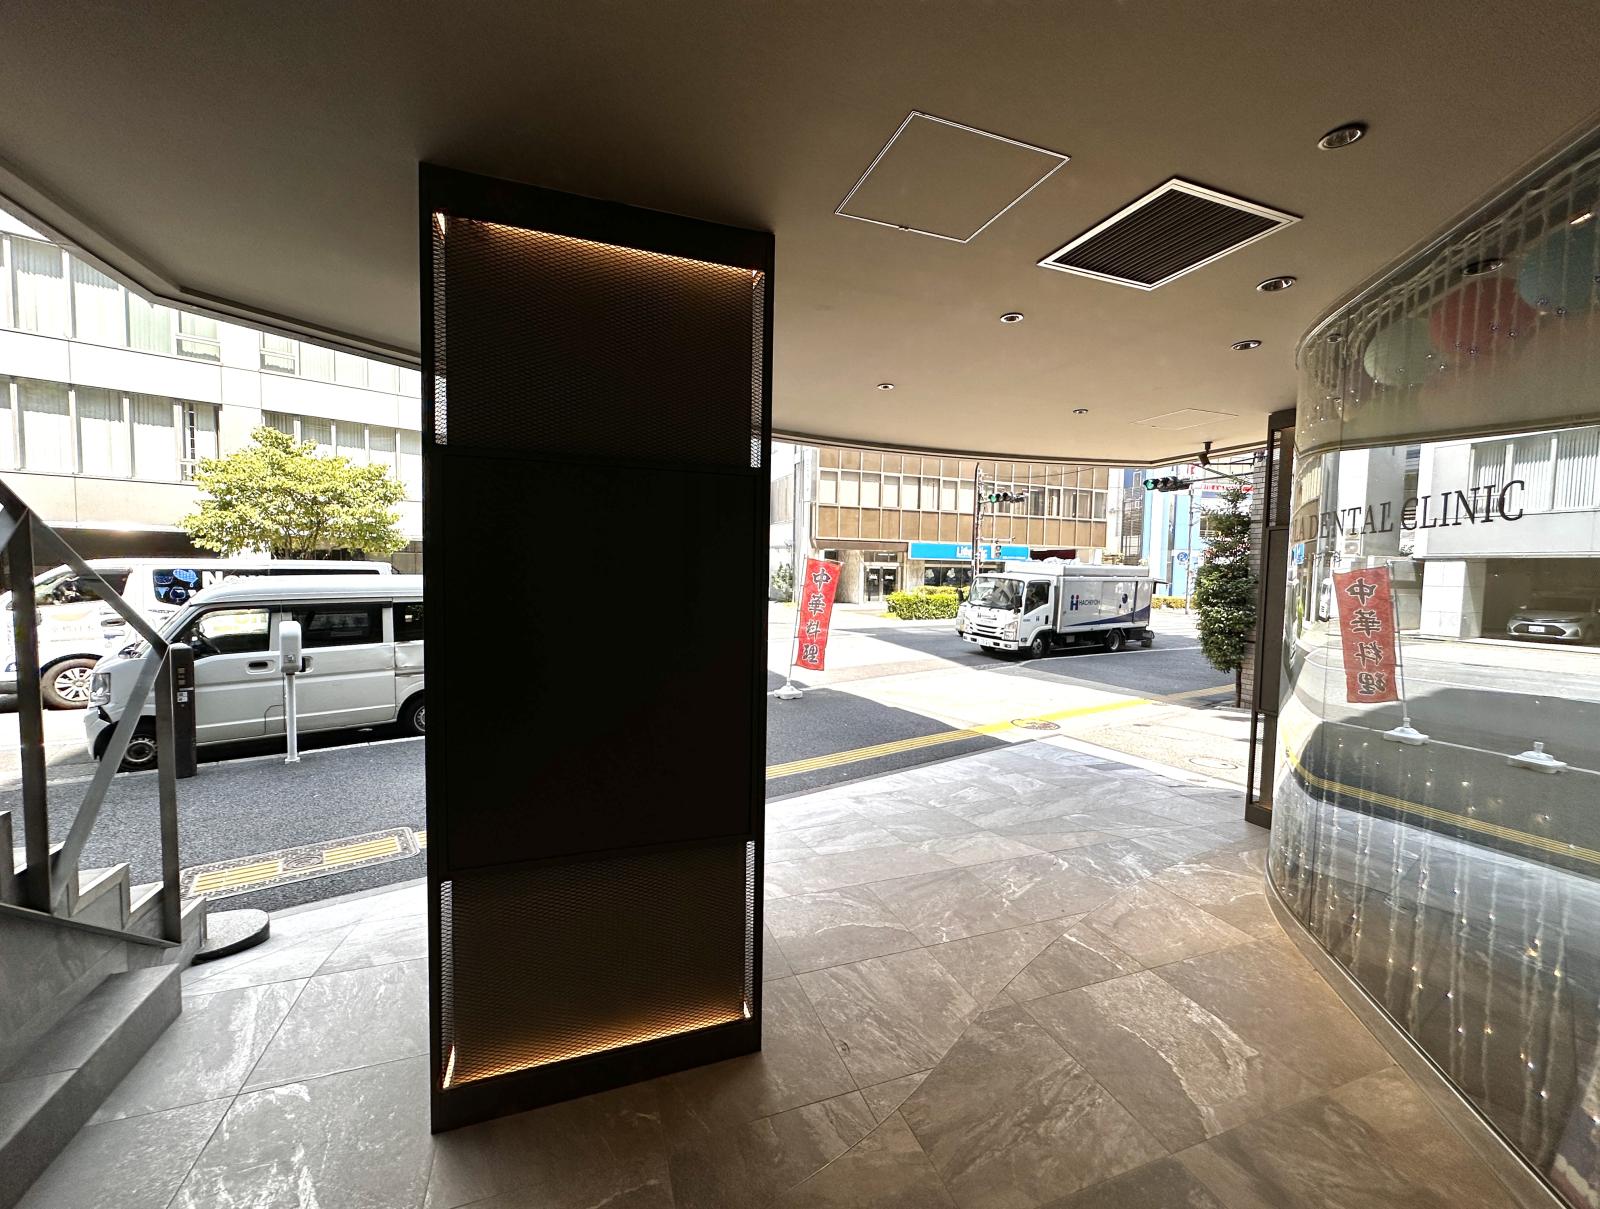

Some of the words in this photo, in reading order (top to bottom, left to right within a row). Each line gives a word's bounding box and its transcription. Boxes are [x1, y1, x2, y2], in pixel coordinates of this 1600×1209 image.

[1307, 501, 1394, 539] DENTAL
[1400, 480, 1525, 530] CLINIC
[802, 567, 832, 663] 中華料理
